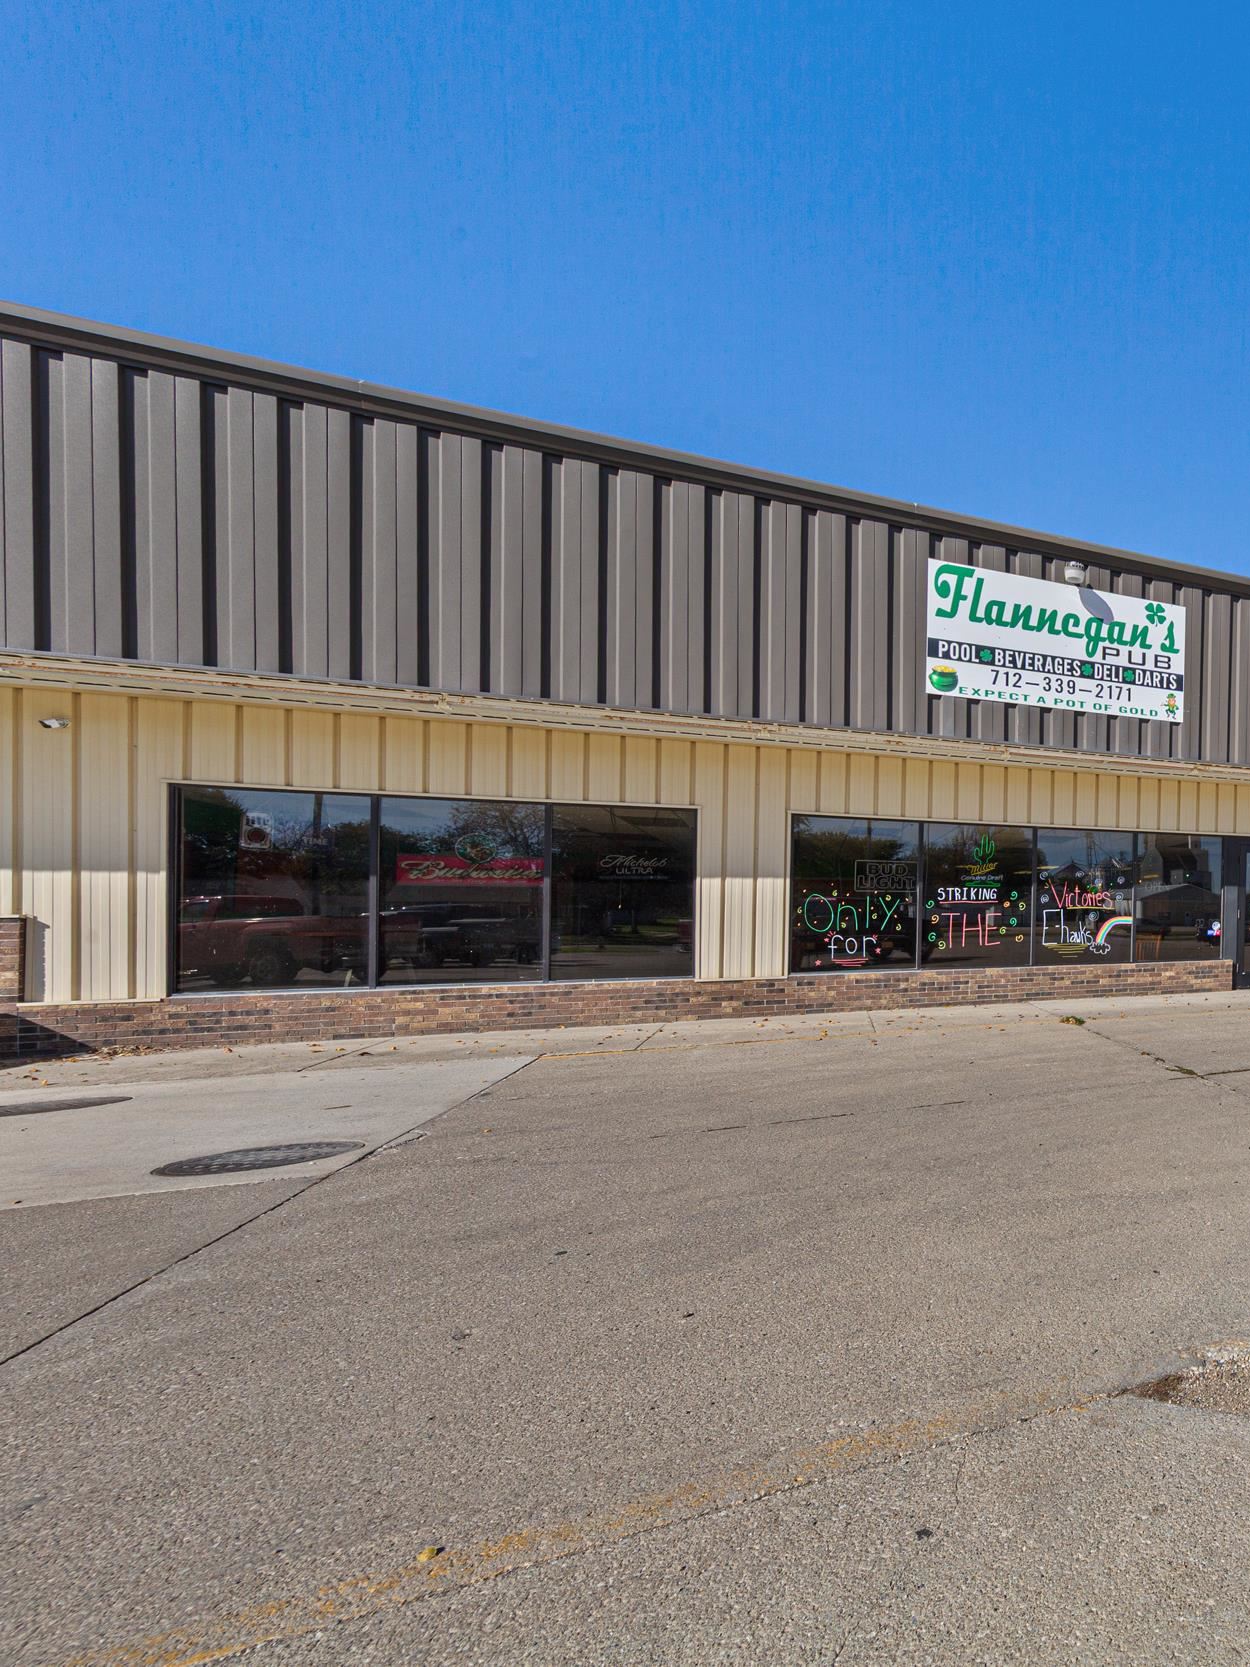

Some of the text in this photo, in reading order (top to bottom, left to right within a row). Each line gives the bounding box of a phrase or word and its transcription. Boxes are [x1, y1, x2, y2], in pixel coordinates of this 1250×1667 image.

[934, 564, 1180, 658] Flannegan's
[938, 640, 1177, 689] POOL BEVERAGES DELI DARTS
[1102, 646, 1172, 669] PUB
[990, 669, 1132, 702] 712-339-2171
[958, 686, 1159, 717] EXPECT A POT OF GOLD
[600, 854, 669, 868] Michelob
[616, 866, 653, 874] ULTRA
[866, 863, 909, 877] BUD
[967, 862, 998, 876] Miller
[857, 875, 915, 889] LIGHT
[937, 887, 998, 900] STRIKING
[1048, 879, 1113, 910] Victories
[941, 912, 1002, 949] THE
[828, 934, 877, 958] for
